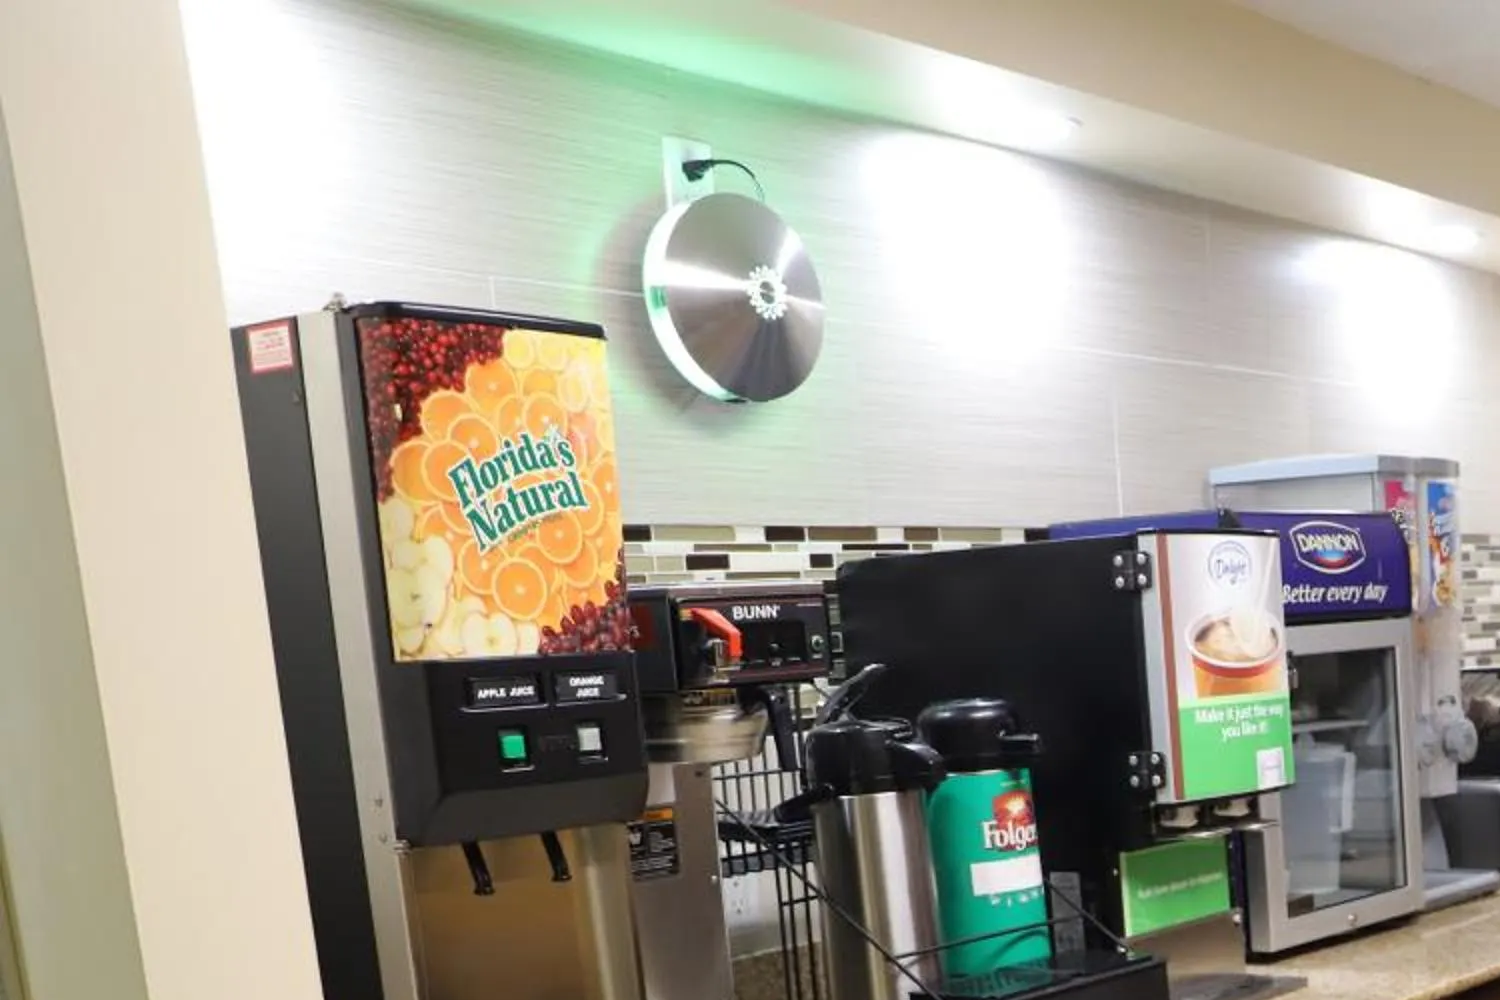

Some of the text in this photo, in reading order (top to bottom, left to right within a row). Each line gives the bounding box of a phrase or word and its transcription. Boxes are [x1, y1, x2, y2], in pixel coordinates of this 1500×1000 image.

[449, 433, 575, 508] Florida's
[466, 472, 588, 551] Natural
[1296, 533, 1360, 552] DANNON
[1283, 581, 1388, 604] Better every day
[732, 604, 778, 620] BUNN
[569, 675, 604, 687] ORANGE
[478, 686, 535, 699] APPLE JUICE
